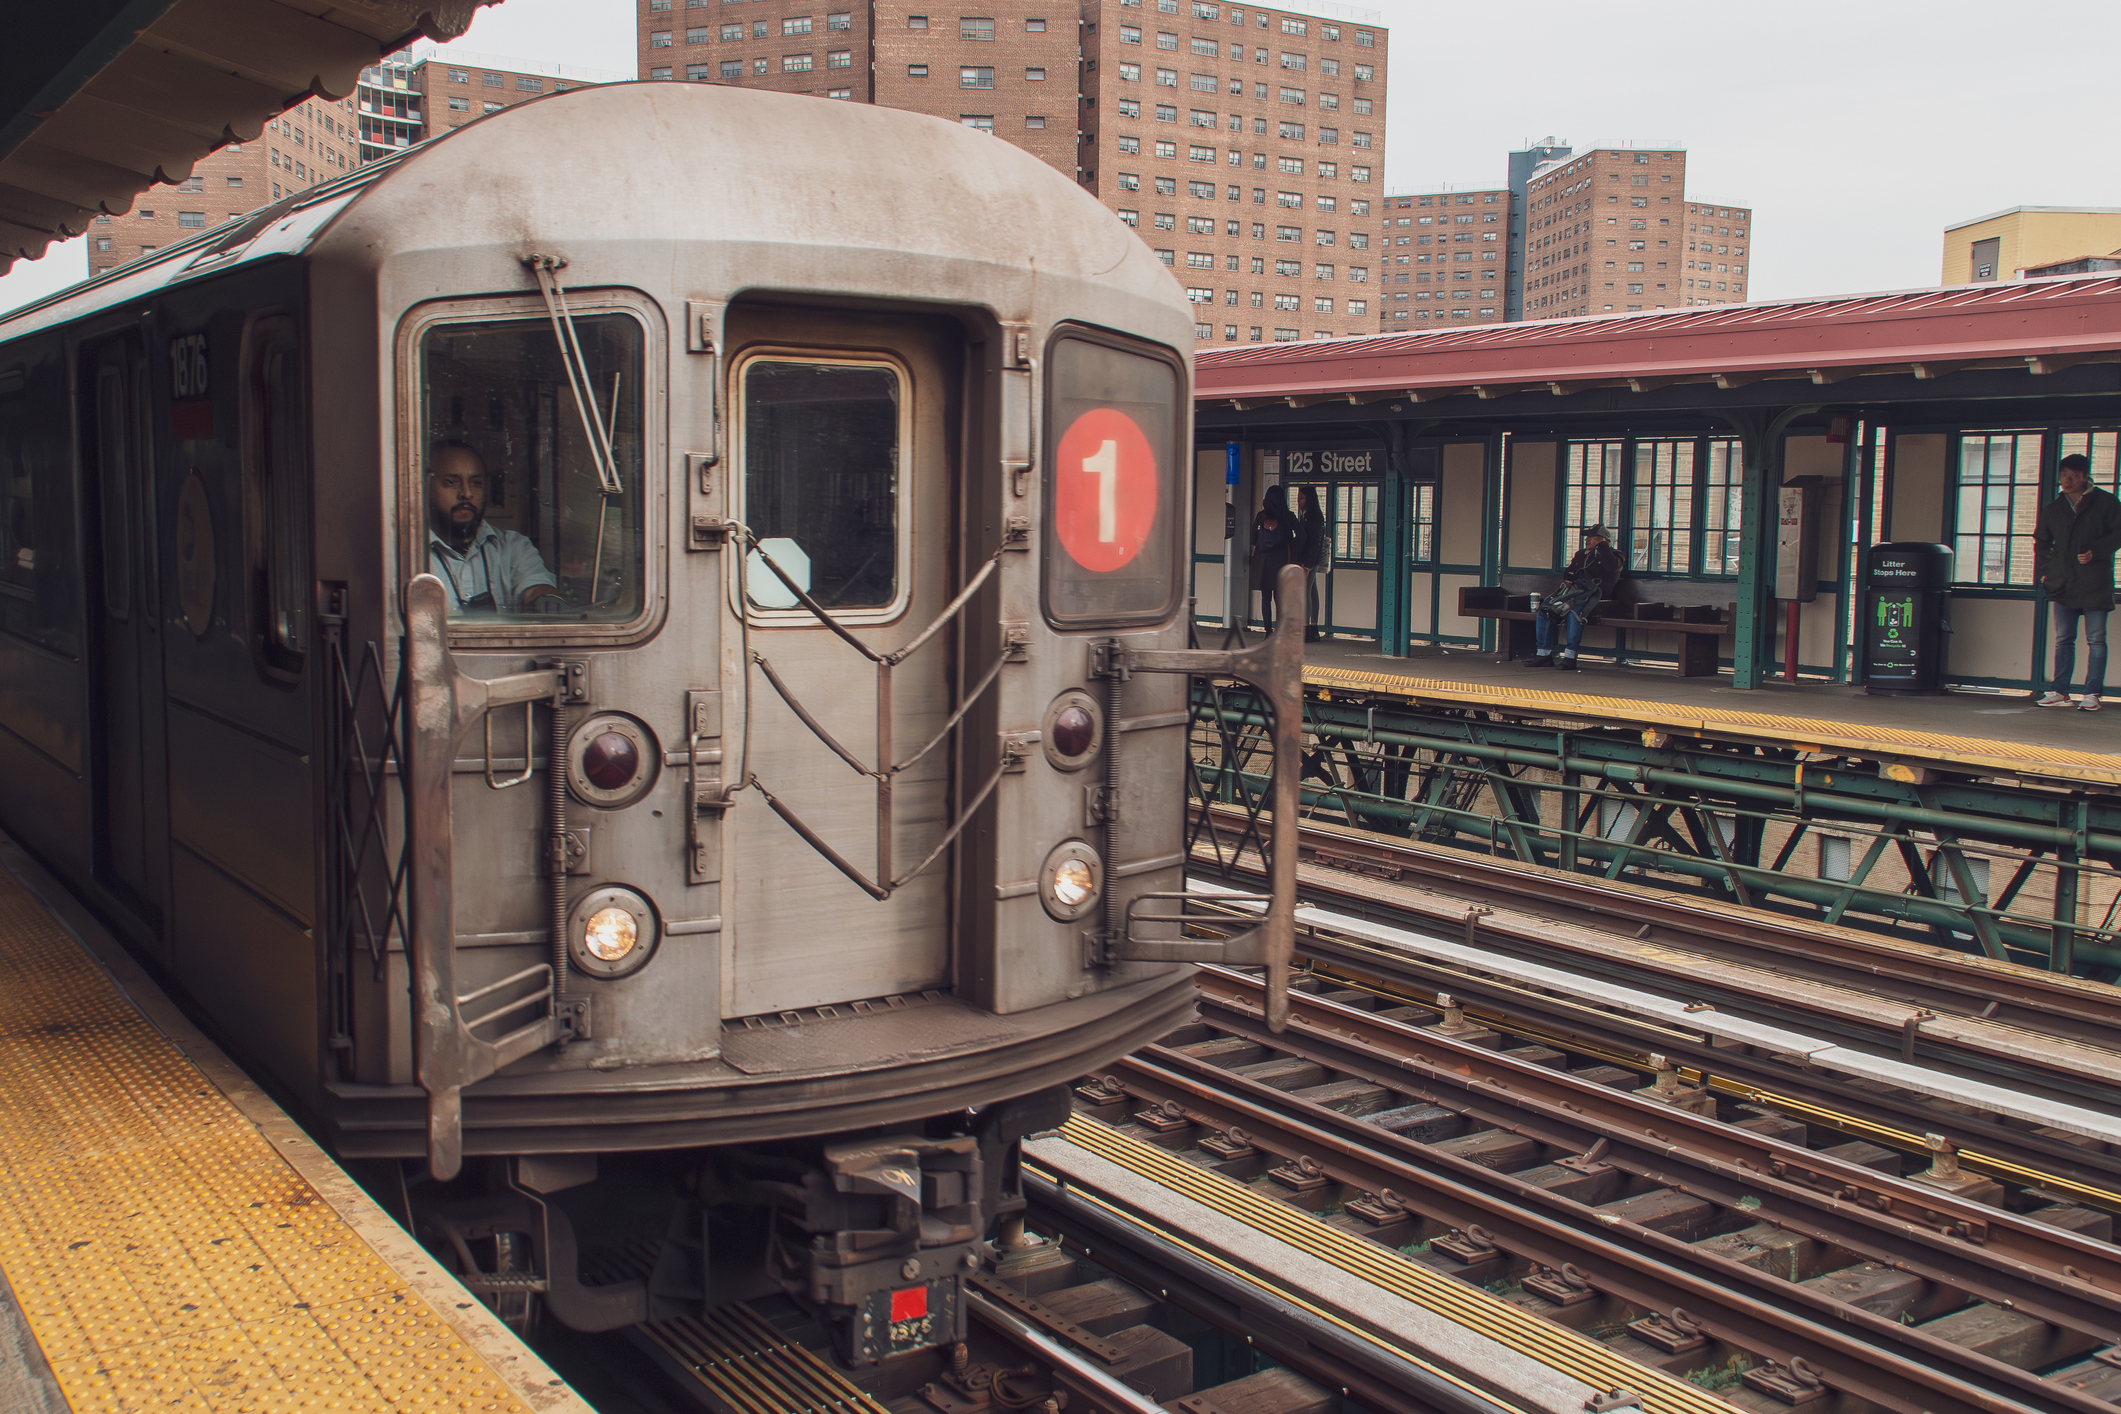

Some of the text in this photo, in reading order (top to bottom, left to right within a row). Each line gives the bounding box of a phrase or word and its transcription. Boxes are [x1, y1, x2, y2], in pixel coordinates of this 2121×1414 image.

[171, 333, 206, 398] 1876
[1287, 452, 1313, 473] 125
[1321, 451, 1372, 473] Street
[1082, 439, 1117, 543] 1
[1873, 568, 1917, 577] Stops Here
[1882, 560, 1906, 568] Litter
